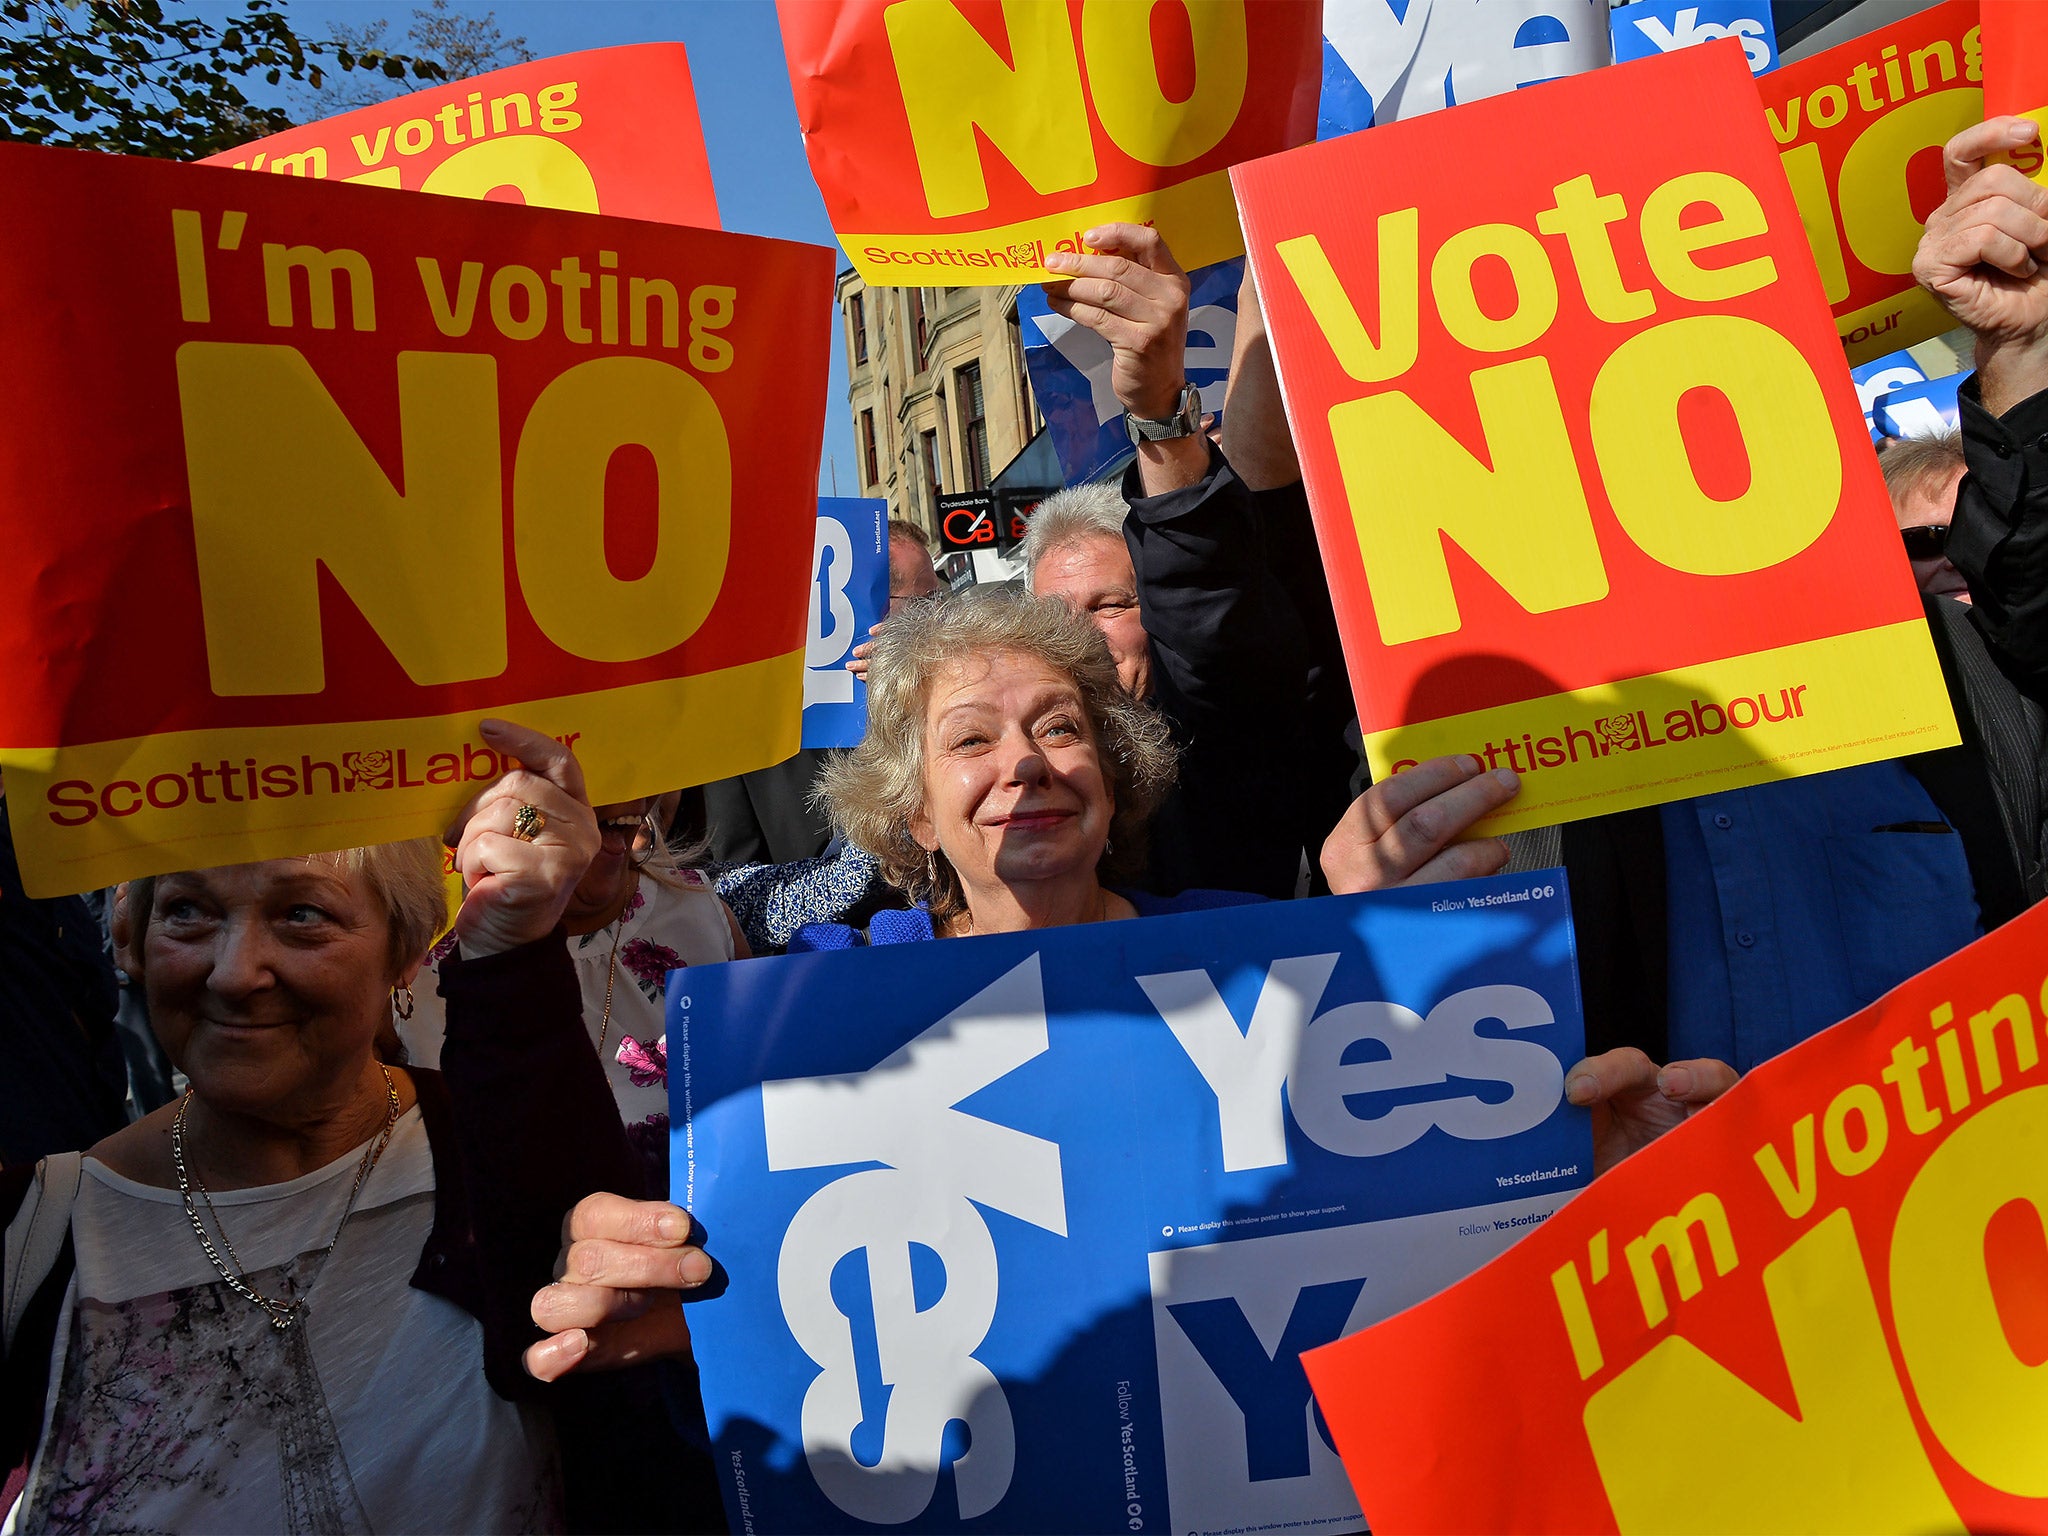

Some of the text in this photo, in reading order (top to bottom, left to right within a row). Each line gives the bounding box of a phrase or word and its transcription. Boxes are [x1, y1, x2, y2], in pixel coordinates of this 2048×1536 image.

[351, 81, 583, 166] voting
[884, 0, 1248, 219] NO
[864, 247, 1011, 268] Scottish
[172, 208, 737, 373] I'm voting
[1276, 171, 1778, 382] Vote
[1328, 315, 1842, 646] NO
[176, 341, 732, 698] NO
[1638, 684, 1807, 752] Labour
[47, 755, 343, 826] Scottish
[1432, 899, 1465, 912] Follow
[682, 1016, 690, 1043] Please
[682, 1043, 691, 1072] display
[1134, 952, 1564, 1173] Yes
[684, 1073, 692, 1088] this
[685, 1089, 693, 1122] window
[686, 1123, 694, 1148] poster
[687, 1150, 694, 1159] to
[688, 1160, 696, 1182] show
[686, 1184, 694, 1203] your
[1551, 1192, 1739, 1381] I'm
[1753, 975, 2048, 1219] votin
[1178, 1225, 1198, 1233] Please
[1199, 1221, 1221, 1231] display
[1222, 1219, 1233, 1227] this
[1235, 1216, 1259, 1225] window
[1261, 1213, 1280, 1223] poster
[1288, 1209, 1305, 1217] show
[1306, 1208, 1320, 1217] your
[1459, 1224, 1490, 1236] Follow
[761, 951, 1068, 1525] Yes
[1117, 1381, 1132, 1420] Follow
[1258, 1522, 1282, 1530] window
[1283, 1520, 1301, 1529] poster
[1311, 1517, 1327, 1525] show
[1328, 1516, 1341, 1524] your
